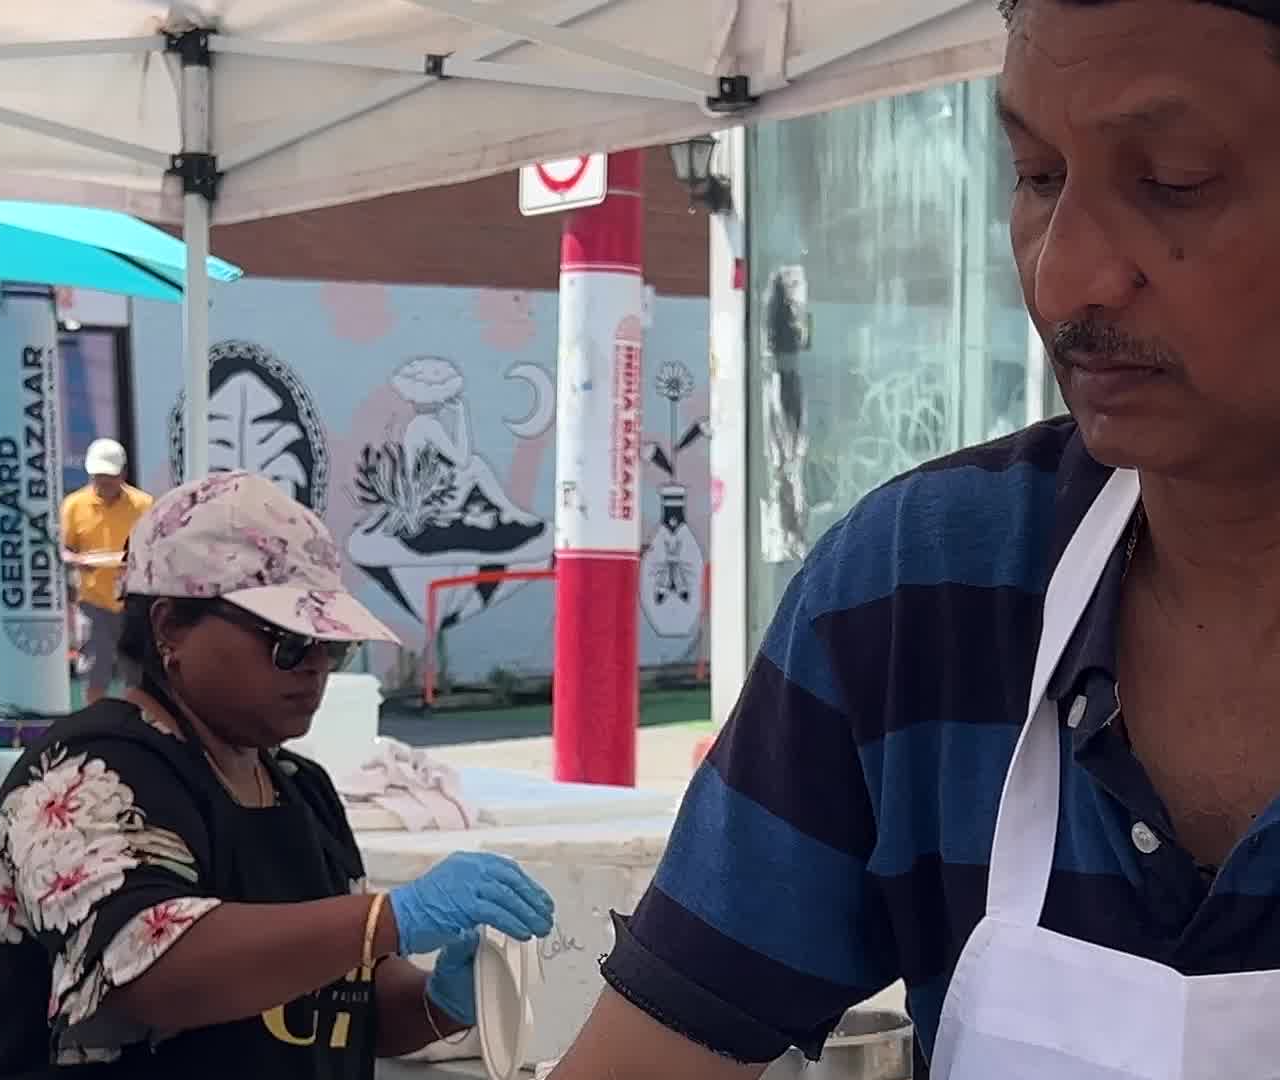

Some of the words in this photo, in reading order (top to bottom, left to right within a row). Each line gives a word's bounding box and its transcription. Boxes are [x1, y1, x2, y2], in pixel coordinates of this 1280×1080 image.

[21, 345, 49, 499] BAZAAR
[622, 419, 634, 520] BAZAAR
[27, 511, 52, 610] INDIA
